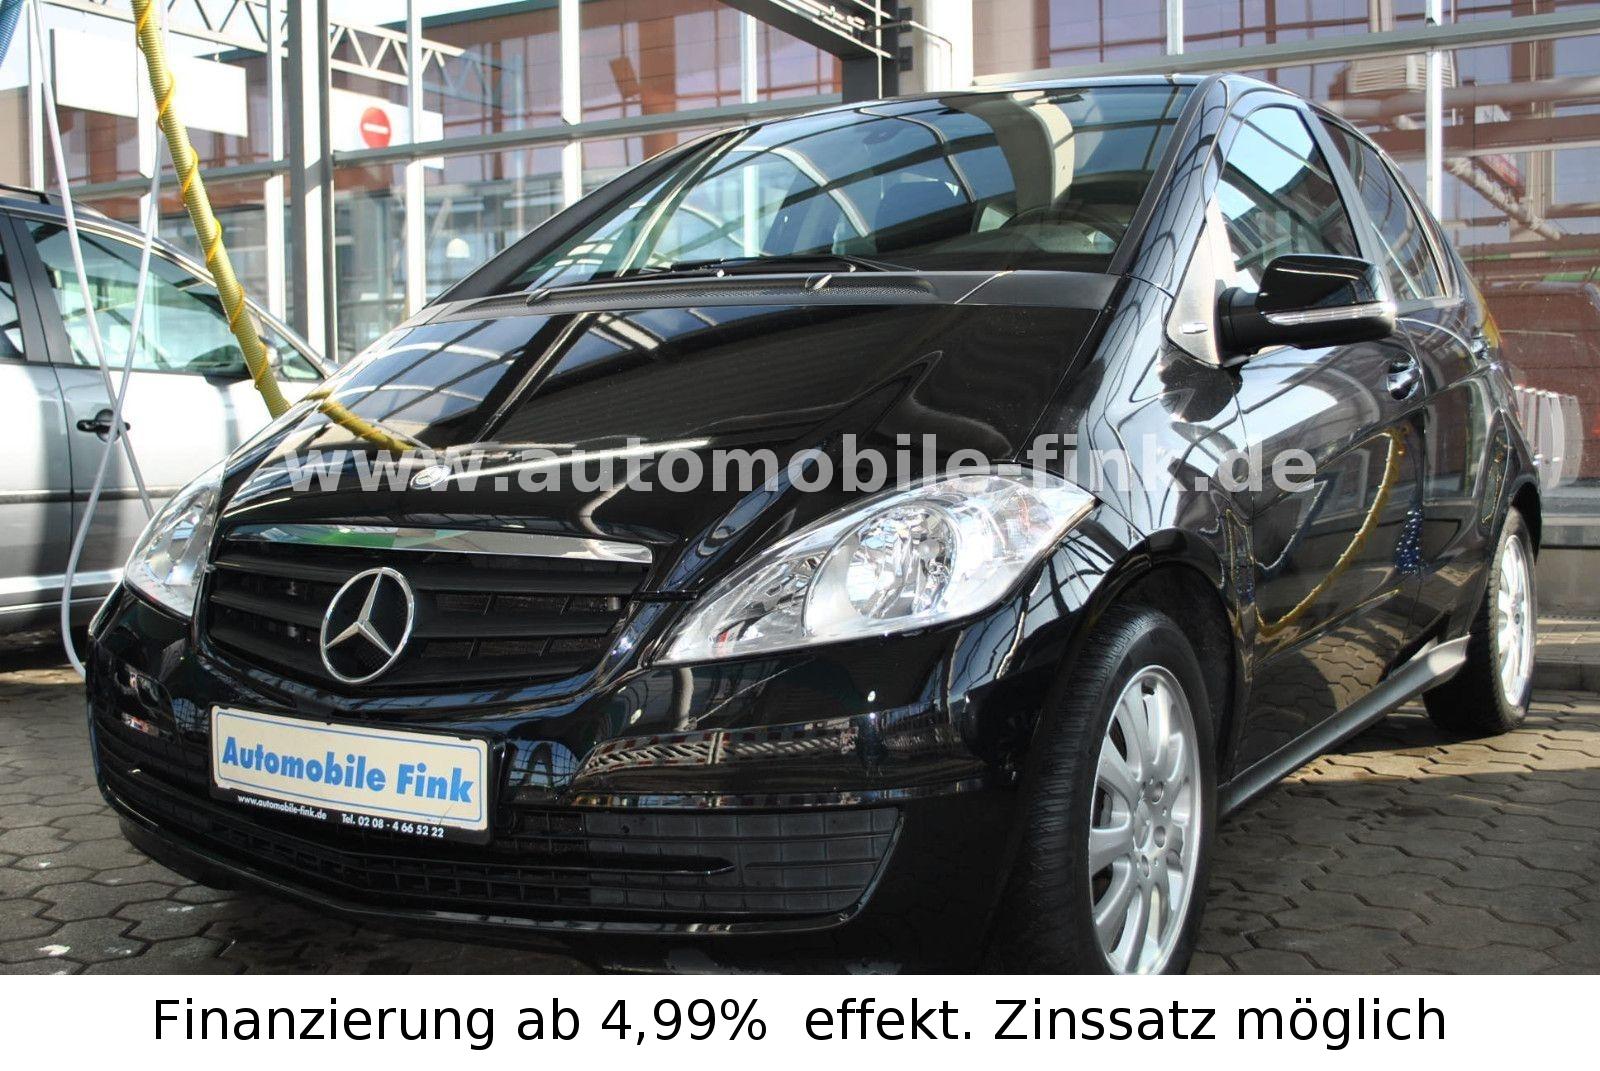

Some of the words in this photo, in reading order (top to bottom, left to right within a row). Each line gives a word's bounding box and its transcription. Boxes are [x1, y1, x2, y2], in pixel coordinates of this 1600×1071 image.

[222, 736, 386, 792] Automobile
[396, 762, 474, 804] Fink
[238, 794, 328, 821] www.automobile-fink.de
[342, 813, 356, 825] Tel.
[358, 815, 370, 827] 02
[371, 816, 384, 829] 08
[392, 820, 399, 832] 4
[401, 822, 414, 835] 66
[416, 824, 429, 837] 52
[431, 826, 444, 839] 22
